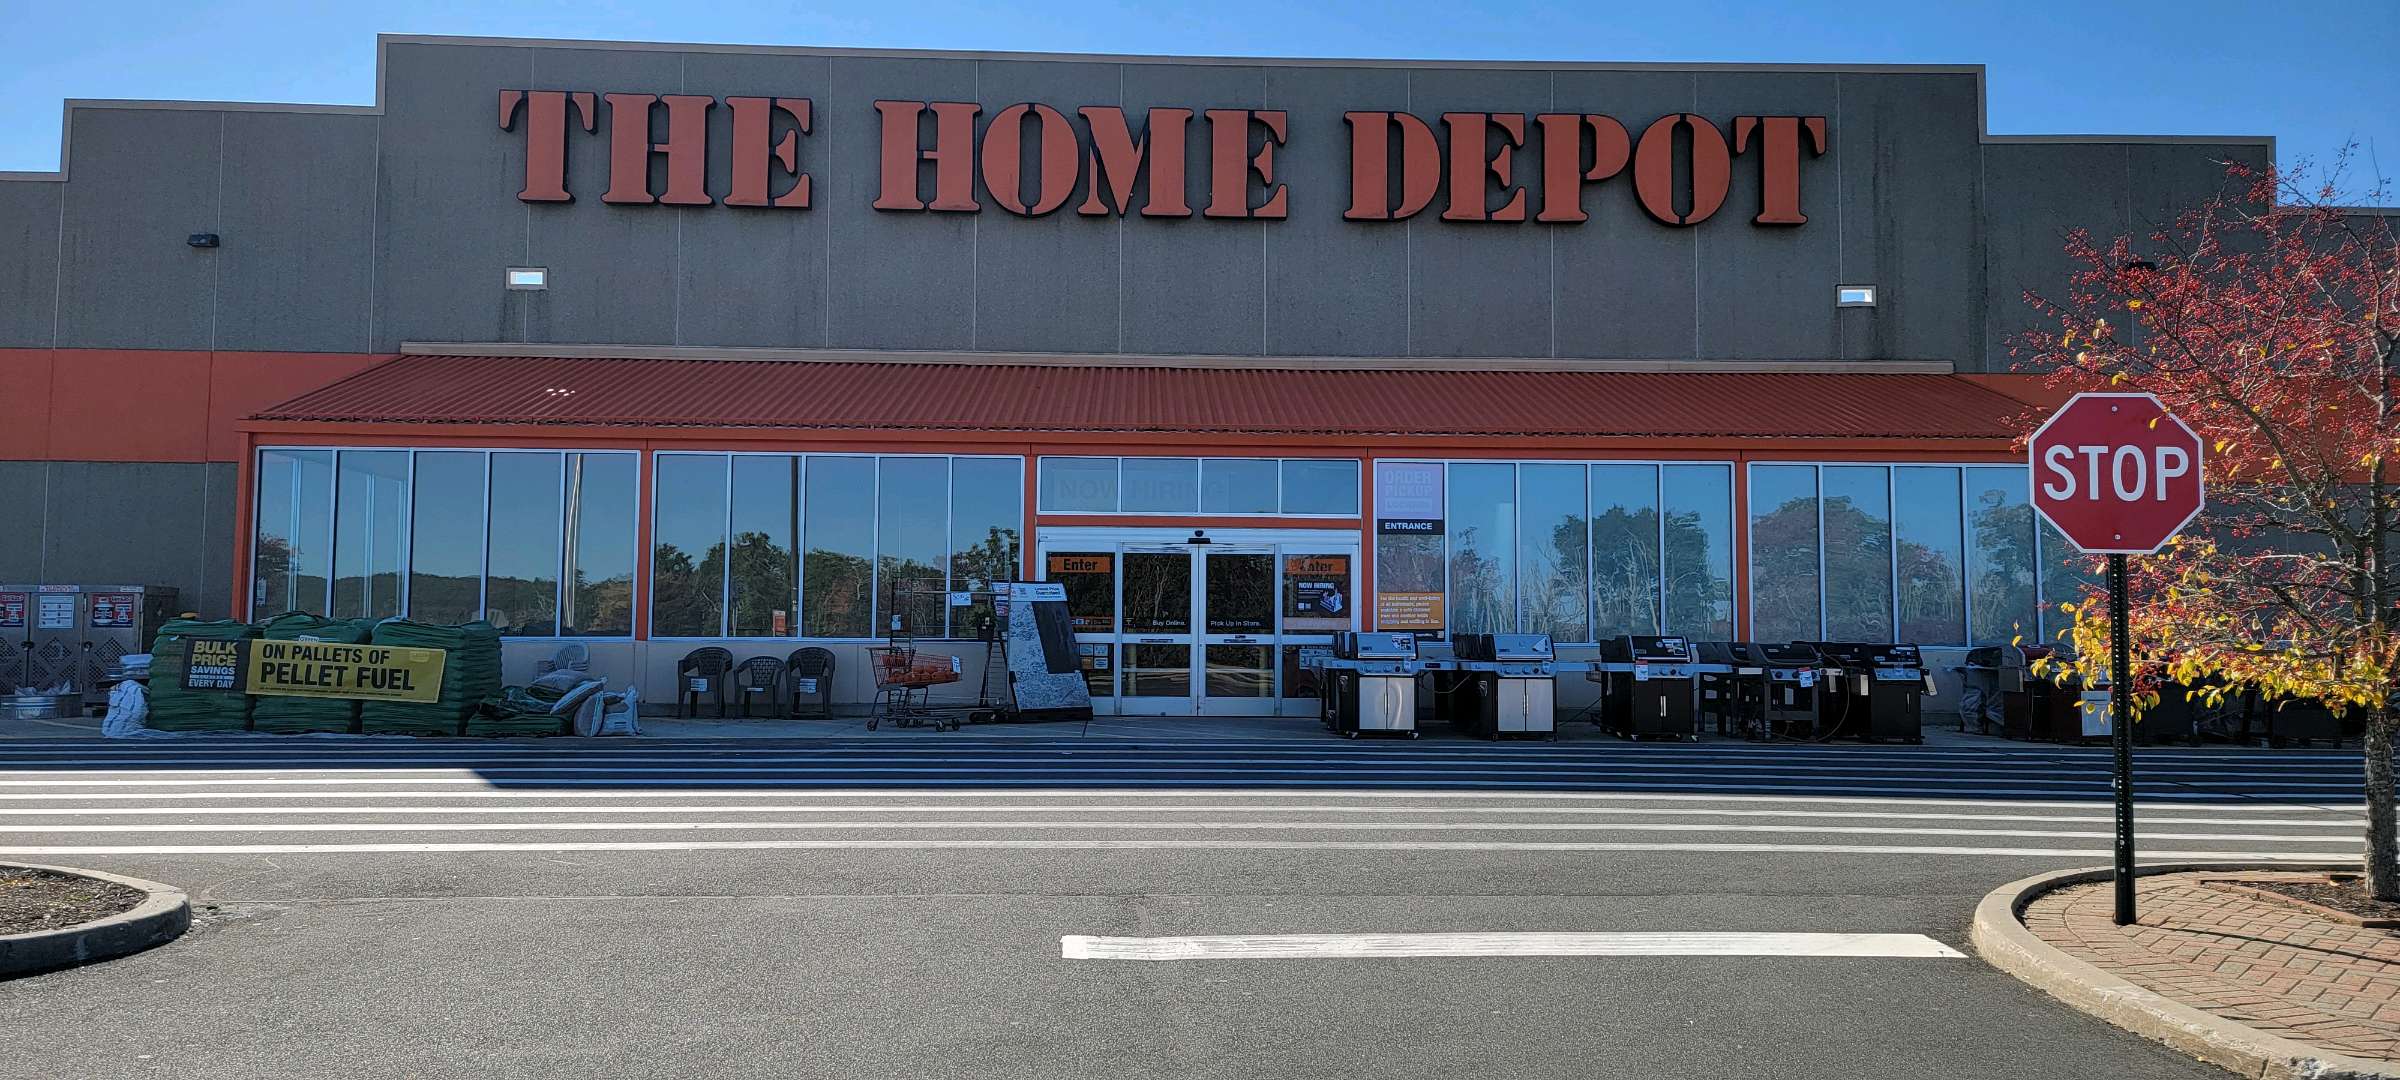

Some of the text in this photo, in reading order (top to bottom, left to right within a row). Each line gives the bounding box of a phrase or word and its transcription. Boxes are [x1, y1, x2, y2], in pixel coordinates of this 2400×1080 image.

[499, 89, 1829, 228] THE HOME DEPOT
[2043, 444, 2189, 501] STOP
[1385, 522, 1433, 530] ENTRANCE
[1063, 558, 1098, 571] Enter
[1301, 560, 1334, 572] nter
[1152, 619, 1164, 627] Buy
[193, 640, 239, 655] BULK
[262, 643, 285, 660] ON
[291, 645, 363, 664] PALLETS
[368, 649, 391, 665] OF
[191, 653, 238, 667] PRICE
[190, 665, 236, 675] SAVINGS
[260, 662, 416, 691] PELLET FUEL
[188, 678, 234, 689] EVERY DAY
